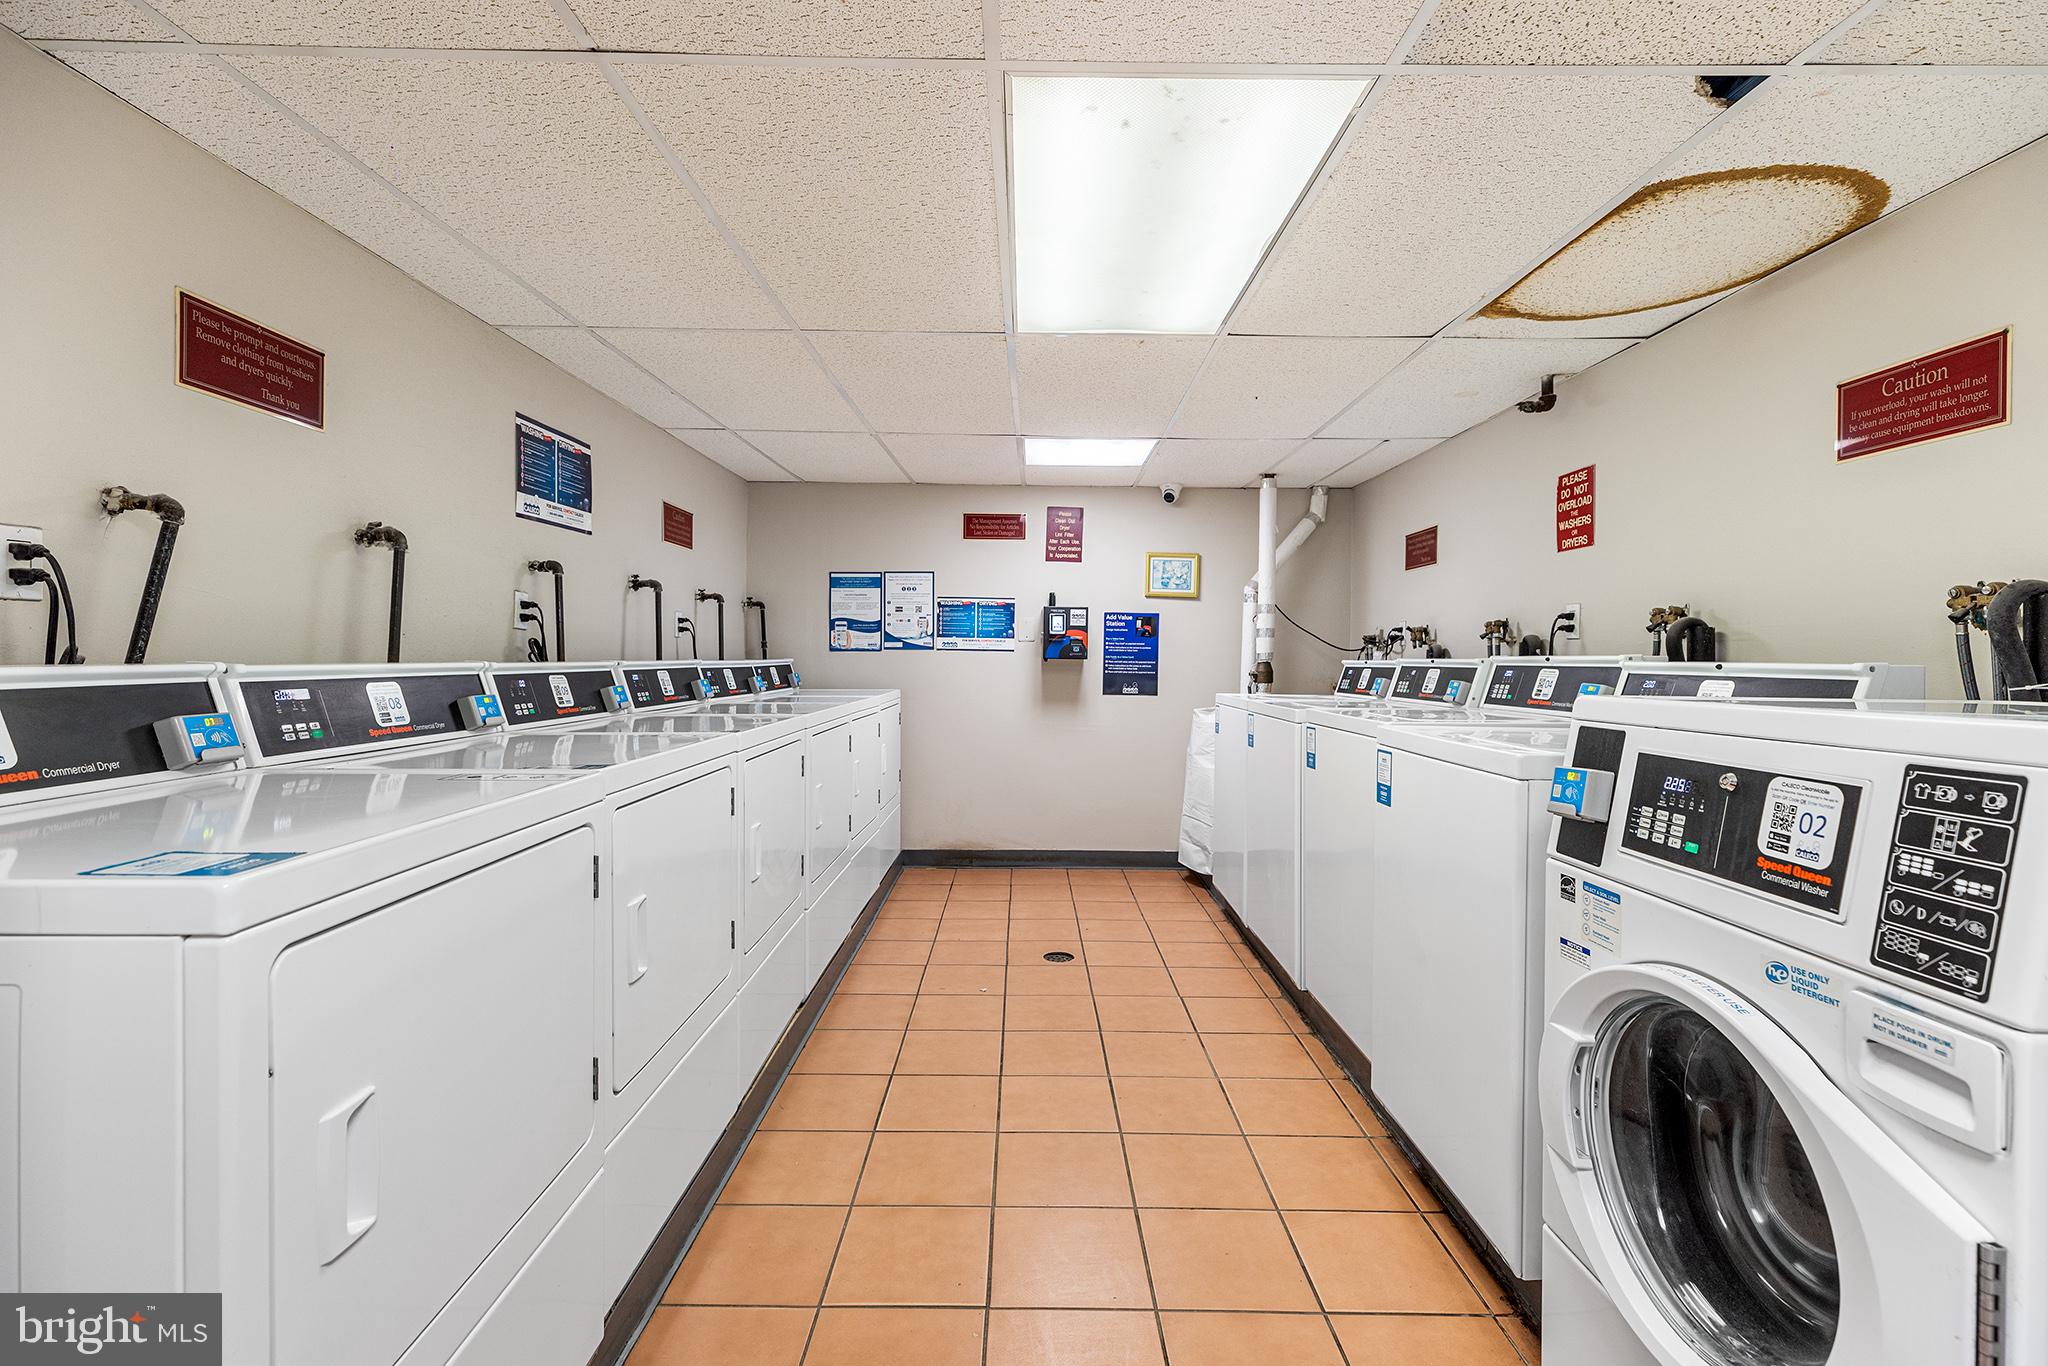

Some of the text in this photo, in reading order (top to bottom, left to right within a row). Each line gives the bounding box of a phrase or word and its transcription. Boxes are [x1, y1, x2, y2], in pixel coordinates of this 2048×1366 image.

[192, 309, 316, 370] Please be prompt and courteous.
[196, 327, 313, 382] Remove clothing from washers
[221, 354, 293, 388] and dryers quickly.
[1882, 365, 1949, 397] Caution
[261, 388, 300, 410] Thank you
[1851, 374, 1988, 421] If you overload, your wash will not
[1849, 388, 1989, 432] be clean and drying will take longer.
[1870, 428, 1892, 439] cause
[1893, 418, 1934, 435] equipment
[1936, 401, 1992, 423] breakdowns.
[520, 423, 544, 440] WASHING
[1562, 470, 1587, 486] PLEASE
[1561, 483, 1589, 499] DO NOT
[1558, 495, 1592, 512] OVERLOAD
[1558, 514, 1592, 531] WASHERS
[1562, 535, 1588, 549] DRYERS
[388, 697, 402, 709] 08
[369, 727, 391, 737] Speed
[0, 761, 120, 784] ueen Commercial Dryer
[1799, 813, 1827, 838] 02
[1756, 856, 1832, 886] Speed Queen
[1762, 870, 1829, 898] Commercial Washer
[1567, 940, 1582, 952] NOTICE
[1791, 966, 1830, 984] USE ONLY
[1791, 976, 1819, 990] LIQUID
[1791, 984, 1840, 1007] DETERGENT
[1725, 999, 1750, 1015] USE
[1874, 1013, 1894, 1026] PLACE
[1896, 1022, 1916, 1034] PODS
[1873, 1023, 1927, 1049] NOT IN DRAWER
